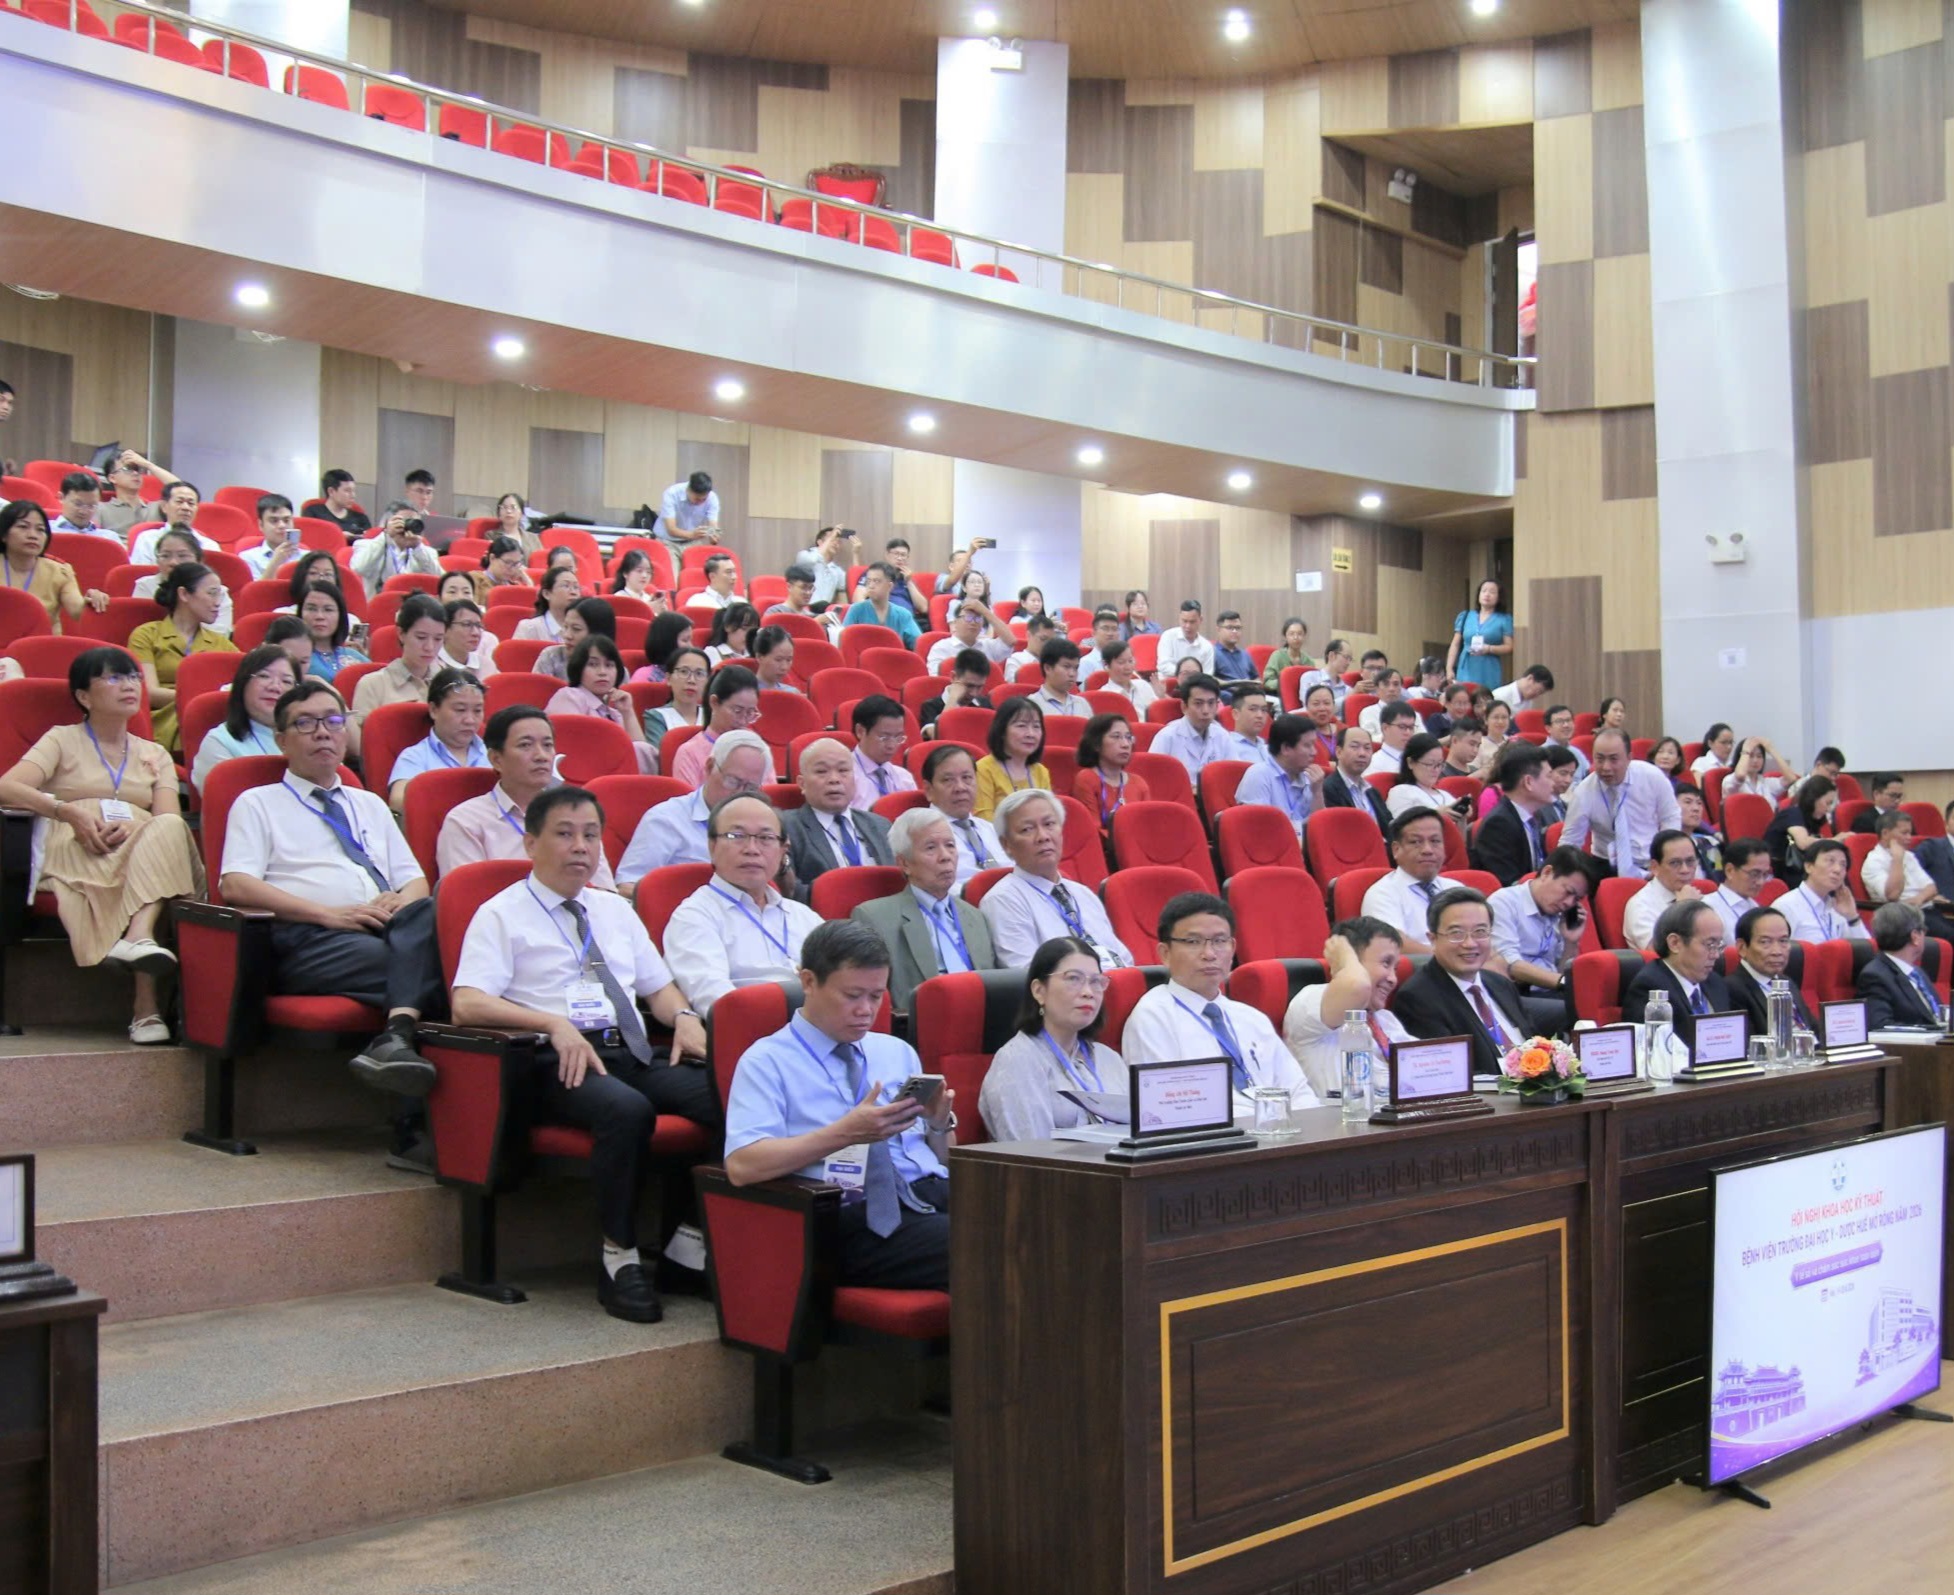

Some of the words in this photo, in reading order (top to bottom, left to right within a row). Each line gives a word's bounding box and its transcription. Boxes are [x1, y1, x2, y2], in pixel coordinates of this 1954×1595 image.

[1822, 1203, 1839, 1217] KHOA
[1742, 1247, 1760, 1268] BỆNH
[1762, 1241, 1777, 1262] VIỆN
